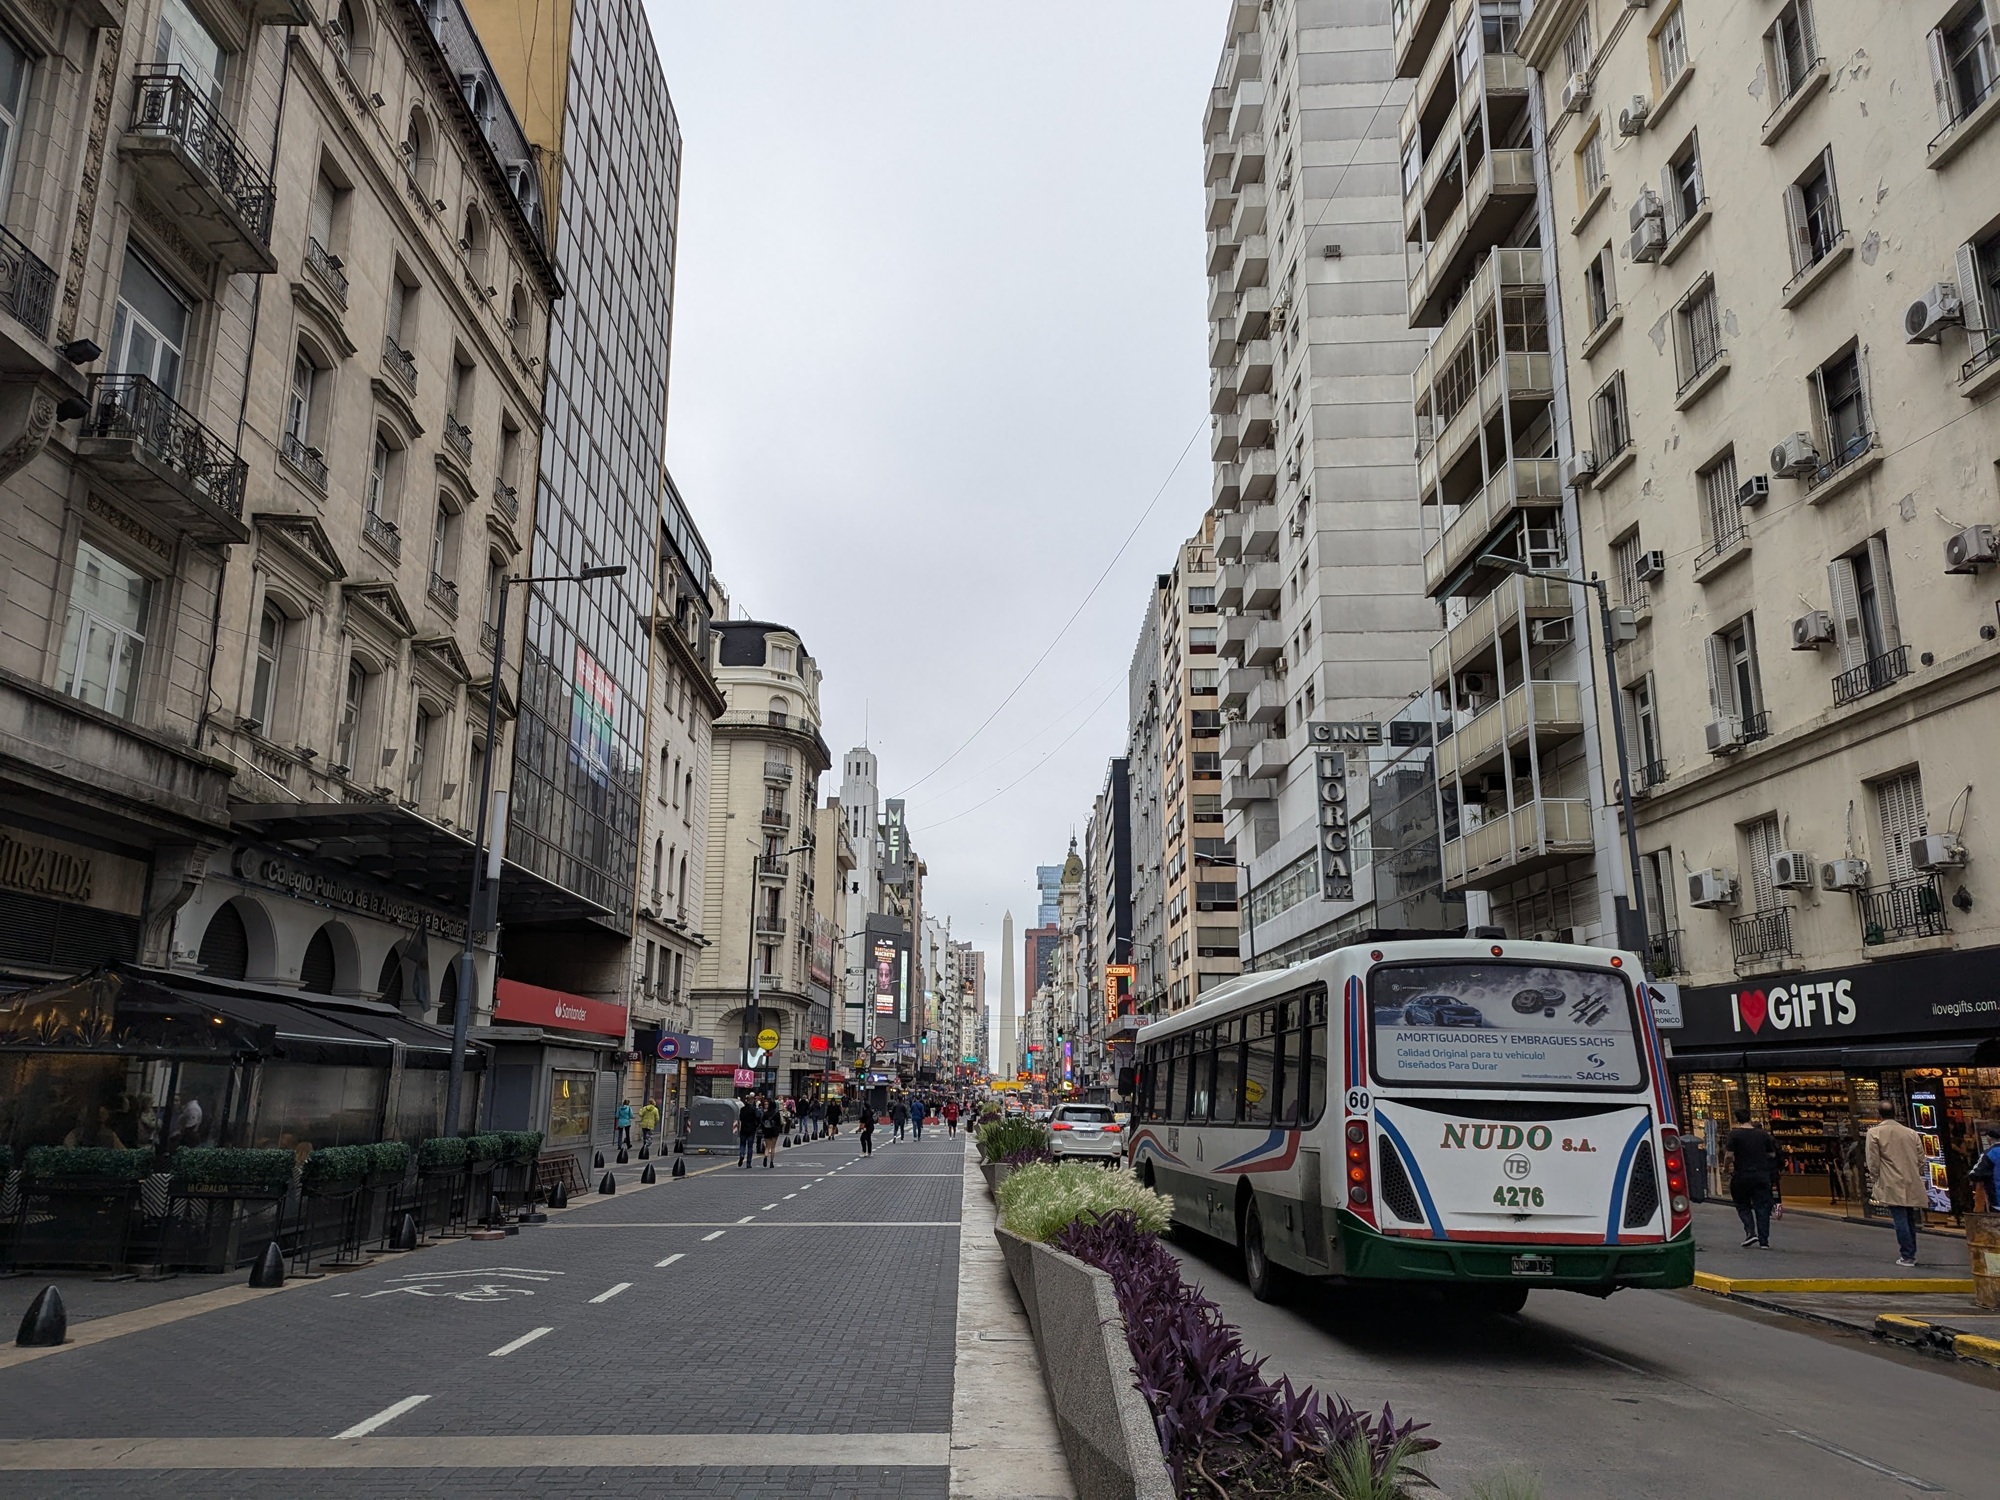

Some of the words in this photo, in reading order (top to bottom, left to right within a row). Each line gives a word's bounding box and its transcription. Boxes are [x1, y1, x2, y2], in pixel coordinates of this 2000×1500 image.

[1313, 725, 1379, 741] CINE
[1319, 755, 1349, 878] LORCA
[888, 808, 901, 865] MET
[267, 860, 313, 893] Colegio
[355, 889, 368, 908] de
[369, 896, 380, 913] la
[562, 1003, 587, 1021] Santander
[1730, 993, 1741, 1032] I
[1396, 1032, 1498, 1044] AMORTIGUADORES
[1500, 1035, 1508, 1044] Y
[1510, 1035, 1578, 1046] EMBRAGUES
[1579, 1037, 1615, 1047] SACHS
[1397, 1049, 1430, 1057] Calidad
[1432, 1049, 1468, 1059] Original
[1505, 1050, 1546, 1060] vehículo!
[1398, 1060, 1447, 1070] Diseñados
[1449, 1062, 1470, 1070] Para
[1472, 1062, 1498, 1070] Durar
[1576, 1072, 1620, 1081] SACHS
[1349, 1091, 1370, 1110] 60
[1440, 1123, 1554, 1152] NUDO
[1506, 1159, 1528, 1174] TB
[1493, 1186, 1545, 1208] 4276
[1513, 1261, 1529, 1272] NNP
[1535, 1261, 1552, 1272] 175
